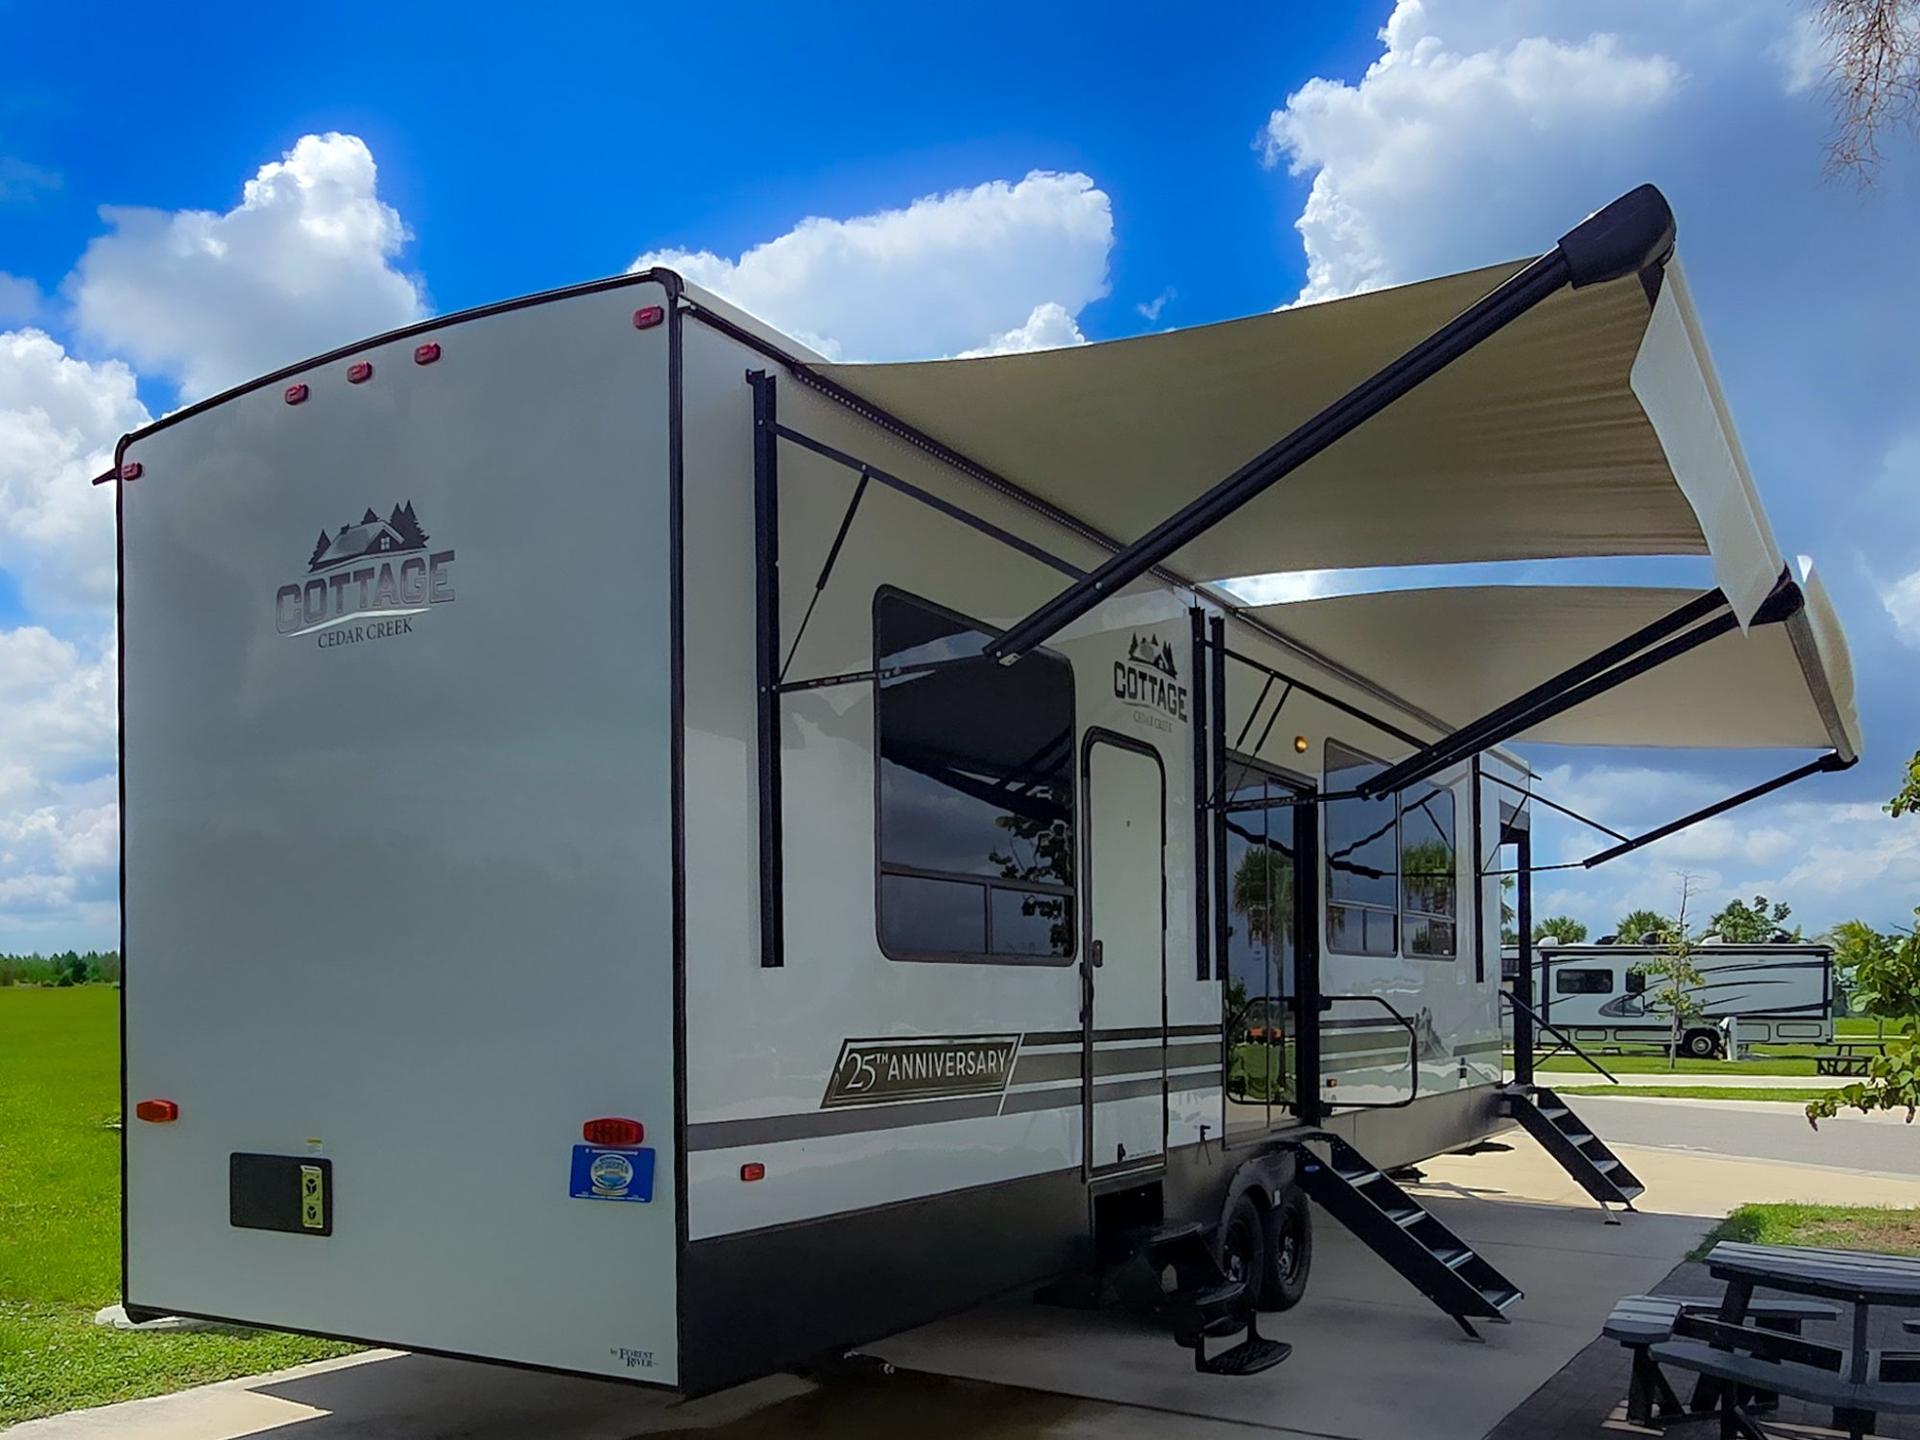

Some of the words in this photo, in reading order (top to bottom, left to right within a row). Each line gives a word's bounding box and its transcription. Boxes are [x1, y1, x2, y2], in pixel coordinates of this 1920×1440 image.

[275, 550, 456, 633] COTTAGE
[318, 629, 364, 649] CEDAR
[366, 617, 413, 641] CREEK
[1113, 660, 1188, 723] COTTAGE
[887, 1049, 1007, 1081] ANNIVERSARY
